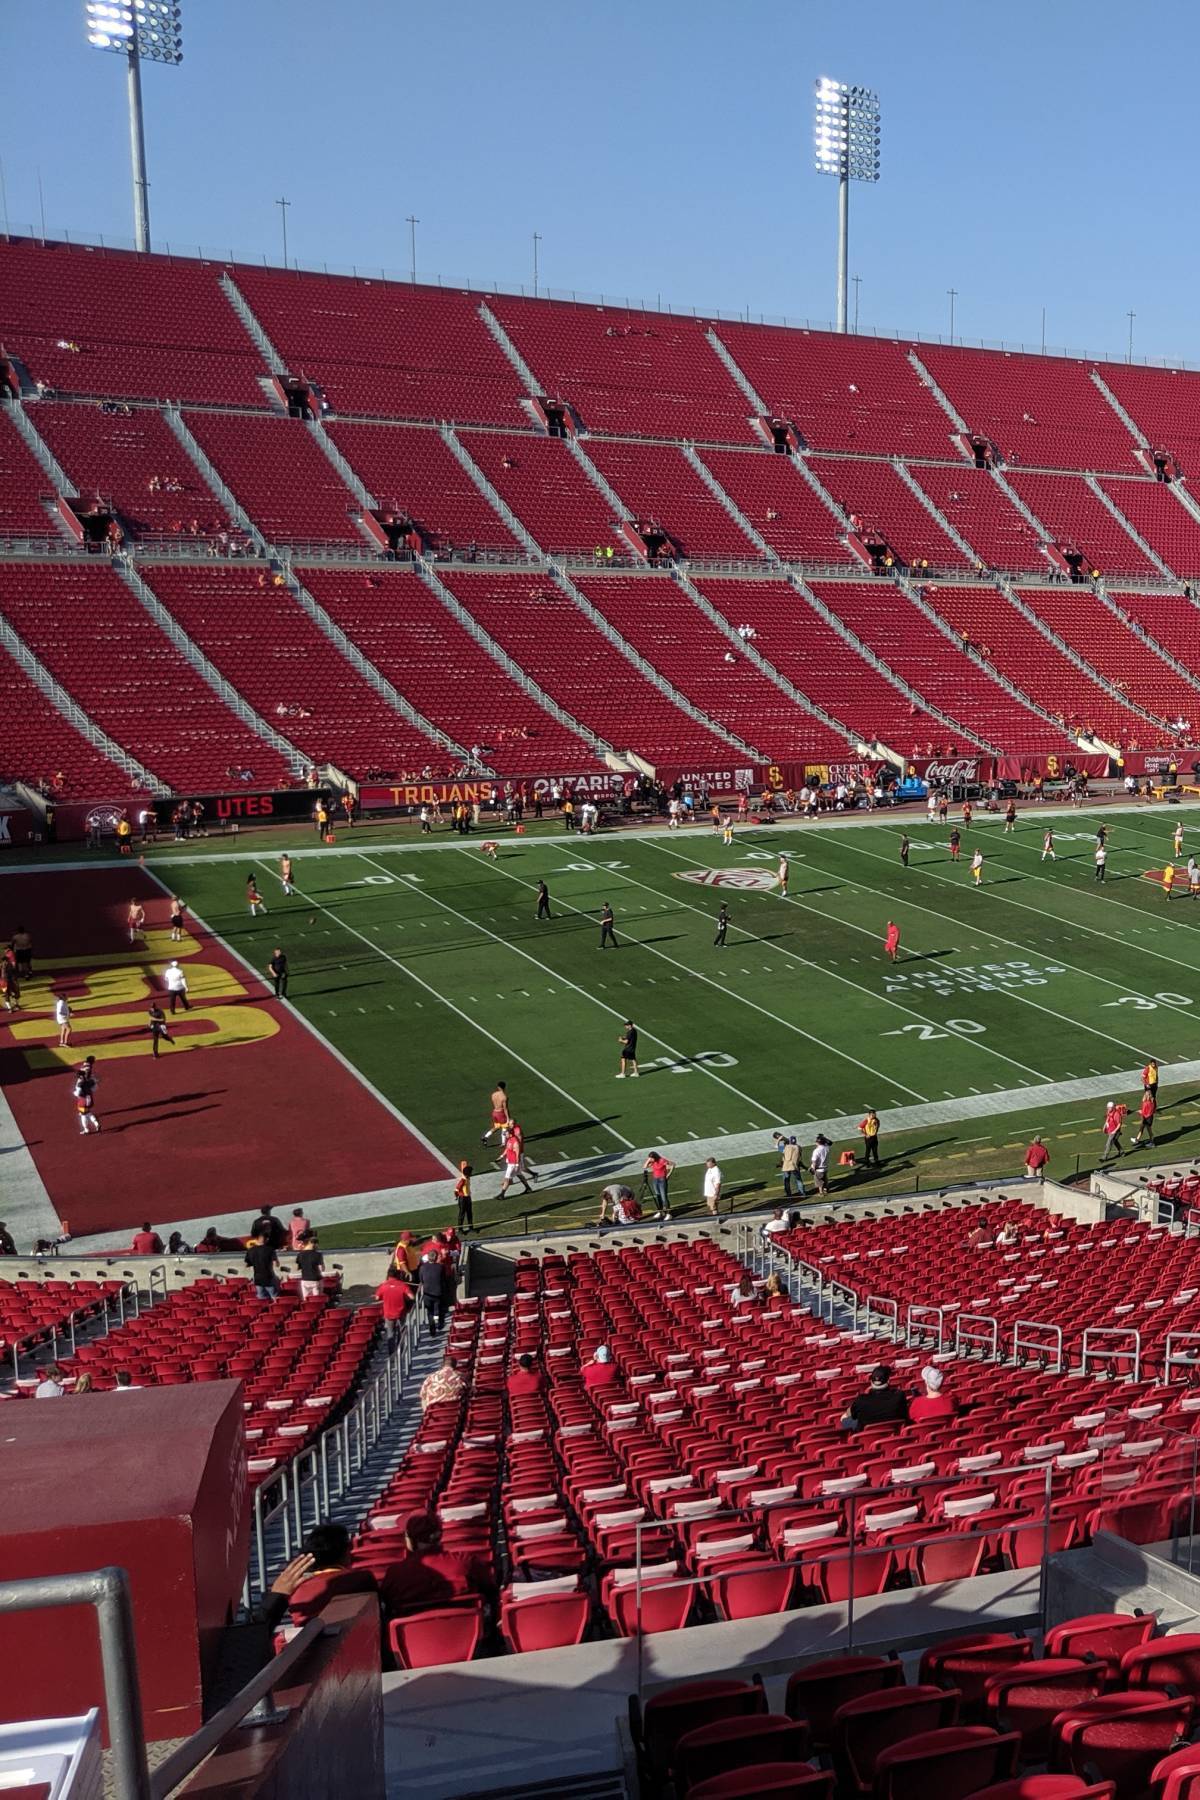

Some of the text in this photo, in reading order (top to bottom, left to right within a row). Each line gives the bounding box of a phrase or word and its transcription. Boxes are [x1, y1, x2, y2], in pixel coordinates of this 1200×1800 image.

[390, 782, 493, 805] TROJANS
[217, 796, 274, 818] UTES
[882, 960, 1032, 983] UNITED
[886, 965, 1067, 994] AIRLINES
[935, 977, 1049, 996] FIELD
[1117, 992, 1194, 1010] 30
[902, 1018, 988, 1041] 20
[653, 1050, 740, 1074] 10
